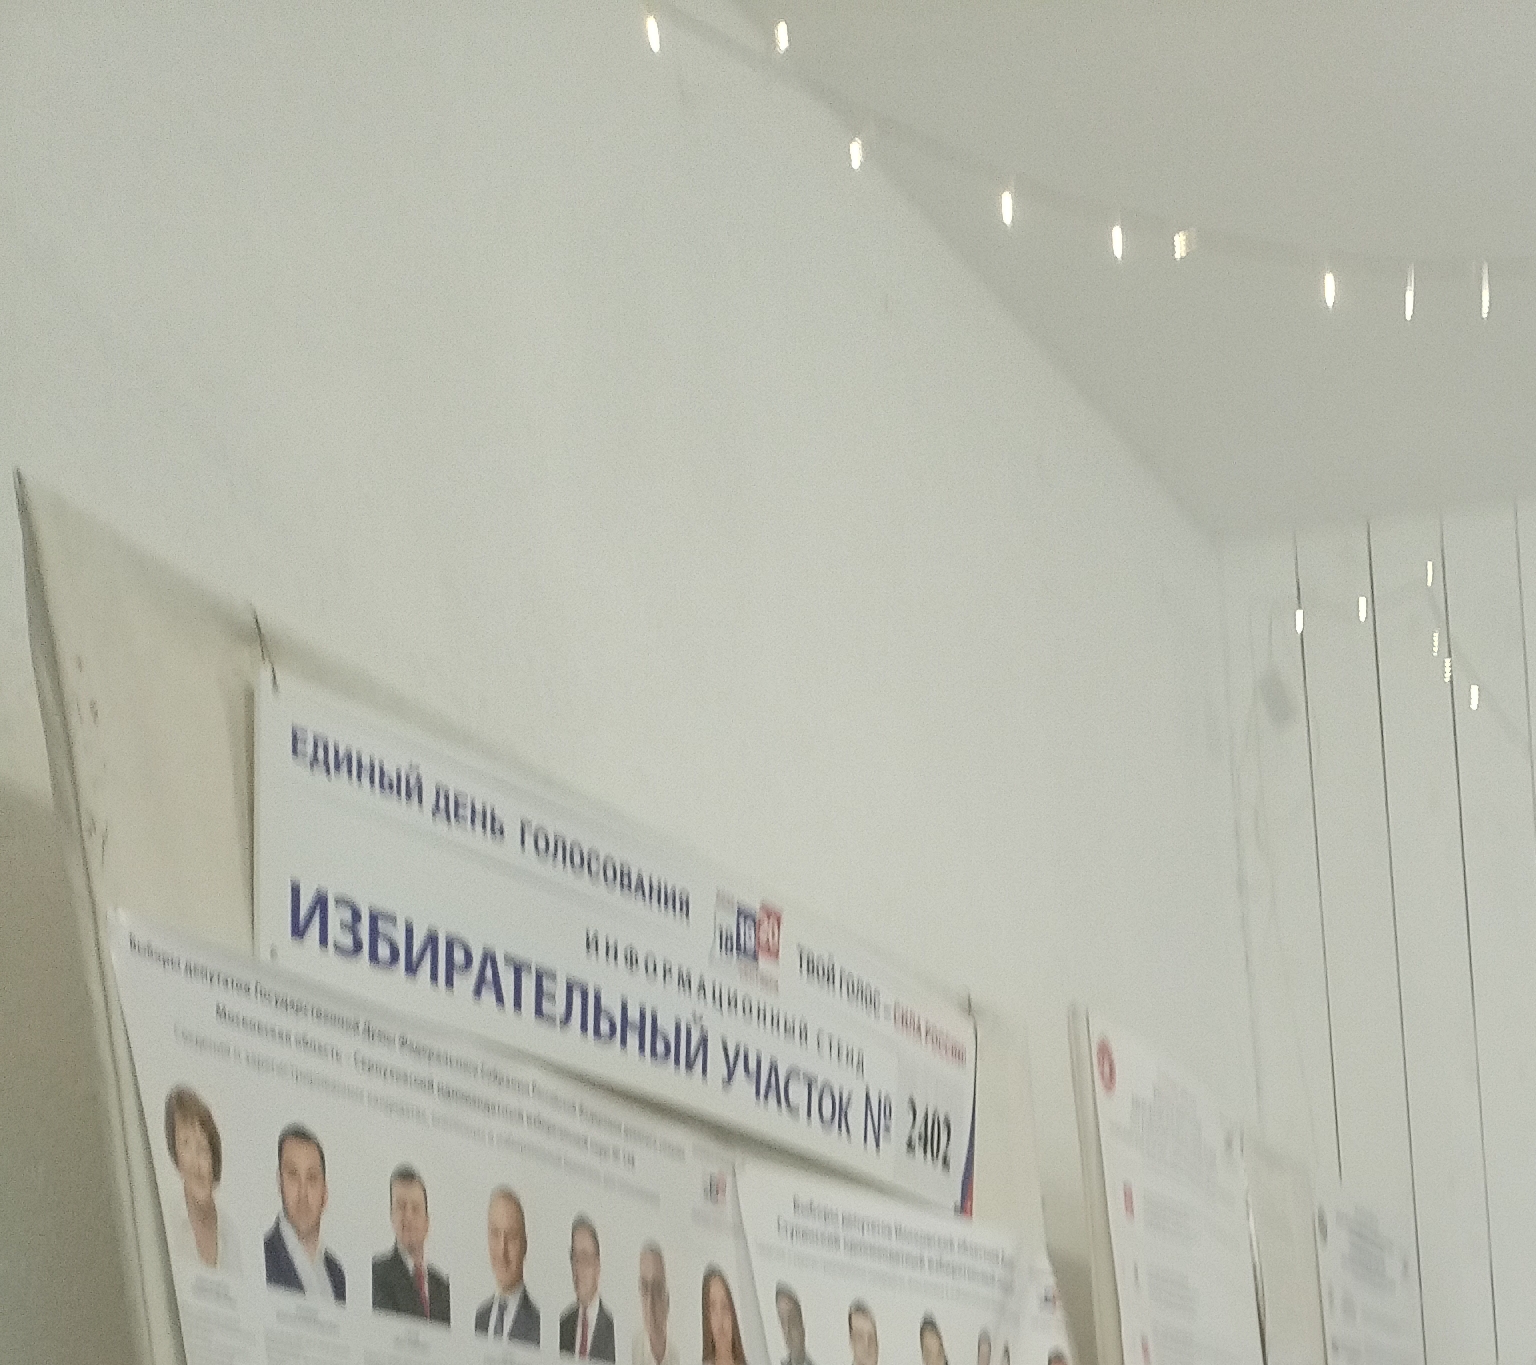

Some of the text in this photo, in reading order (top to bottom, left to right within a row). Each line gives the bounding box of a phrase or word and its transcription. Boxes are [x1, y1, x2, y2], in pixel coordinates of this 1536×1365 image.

[291, 722, 690, 923] ЕДИНЫЙ ДЕНЬ ГОЛОСОВАНИЯ
[288, 876, 709, 1084] ИЗБИРАТЕЛЬНЫЙ
[720, 1033, 852, 1144] УЧАСТОК
[906, 1093, 951, 1173] 2402
[585, 926, 808, 1047] ИНФОРМАЦИОННЫЙ
[816, 1028, 865, 1079] СТЕНД
[797, 943, 837, 996] ТВОЙ
